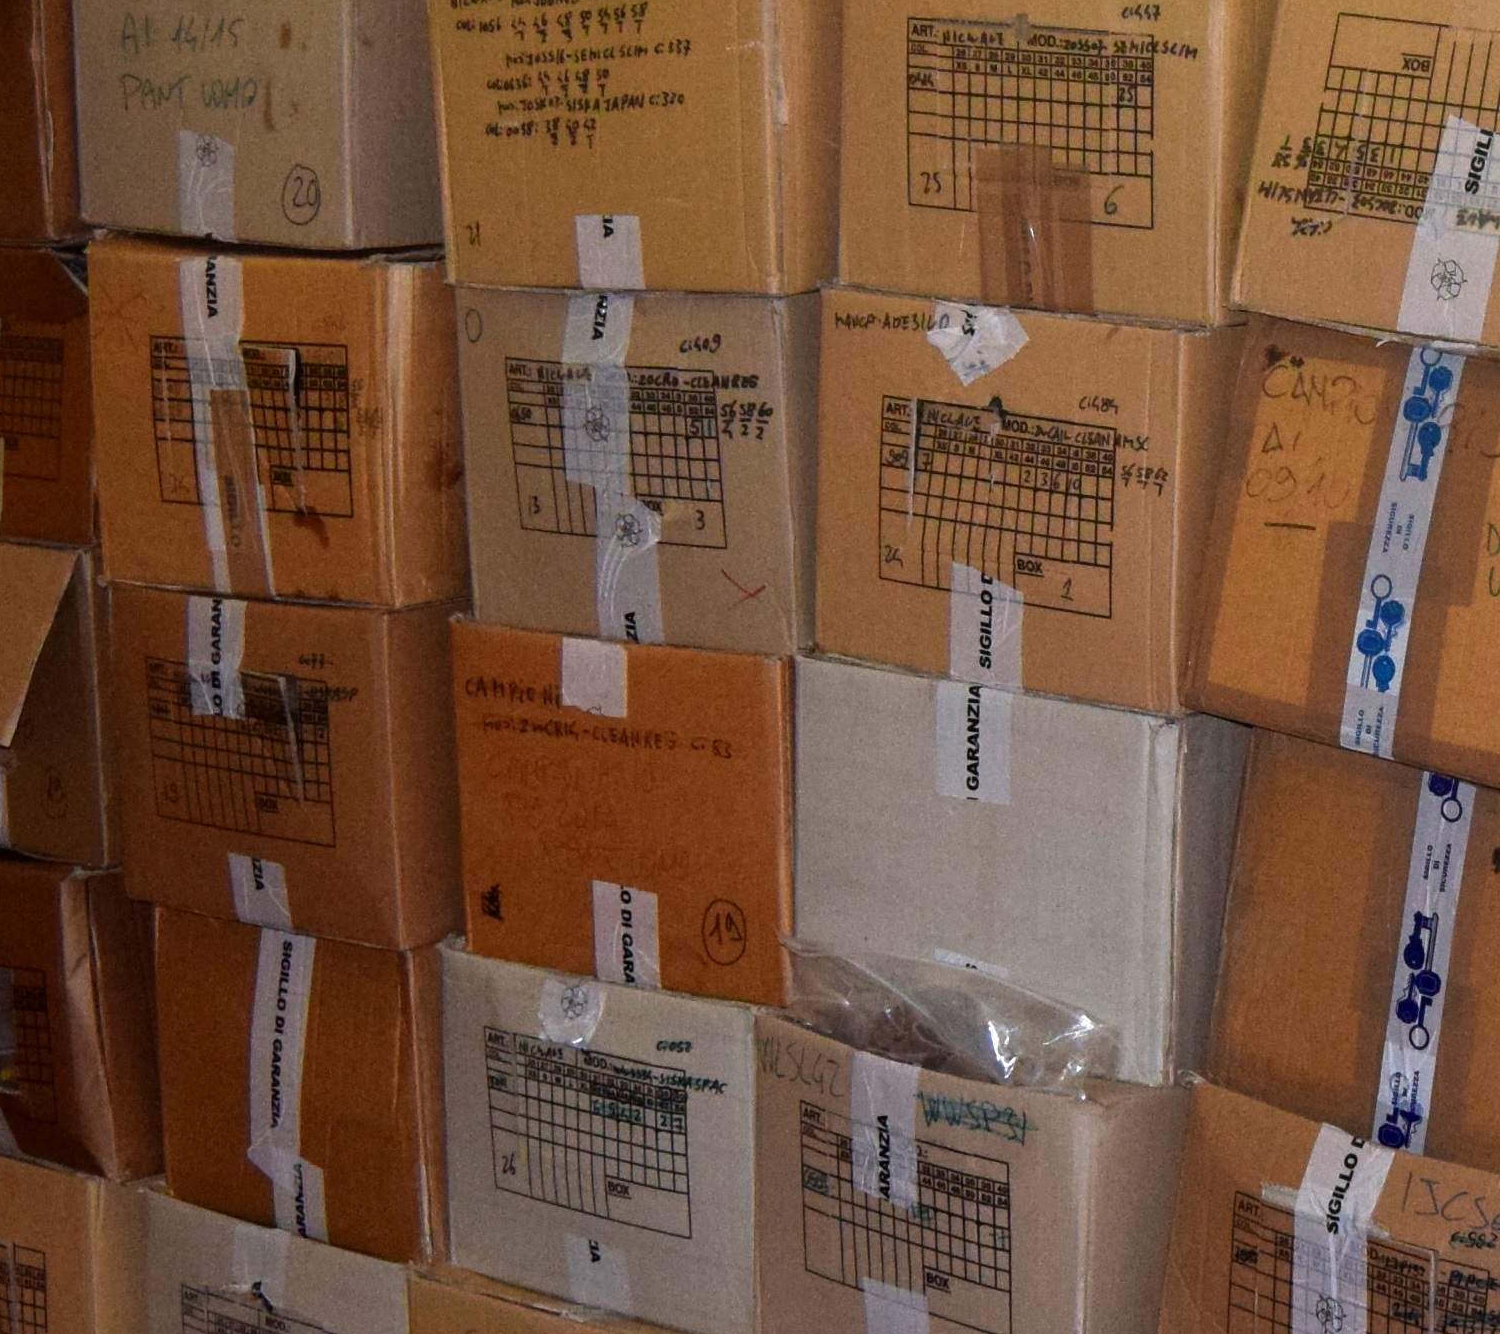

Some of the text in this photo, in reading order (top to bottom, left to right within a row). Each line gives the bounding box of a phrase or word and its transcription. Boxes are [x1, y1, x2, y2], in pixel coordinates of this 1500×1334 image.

[1402, 56, 1431, 72] BOX
[292, 175, 320, 208] 20
[1016, 558, 1044, 575] BOX
[979, 587, 994, 669] SIGILLO
[966, 683, 984, 790] GARANZIA
[708, 912, 743, 946] 19
[269, 940, 293, 1131] SIGILLO GARANZIA
[877, 1114, 891, 1200] ARANZIA
[607, 1181, 630, 1196] BOX
[1325, 1153, 1359, 1235] SIGILLO
[925, 1272, 950, 1289] BOX
